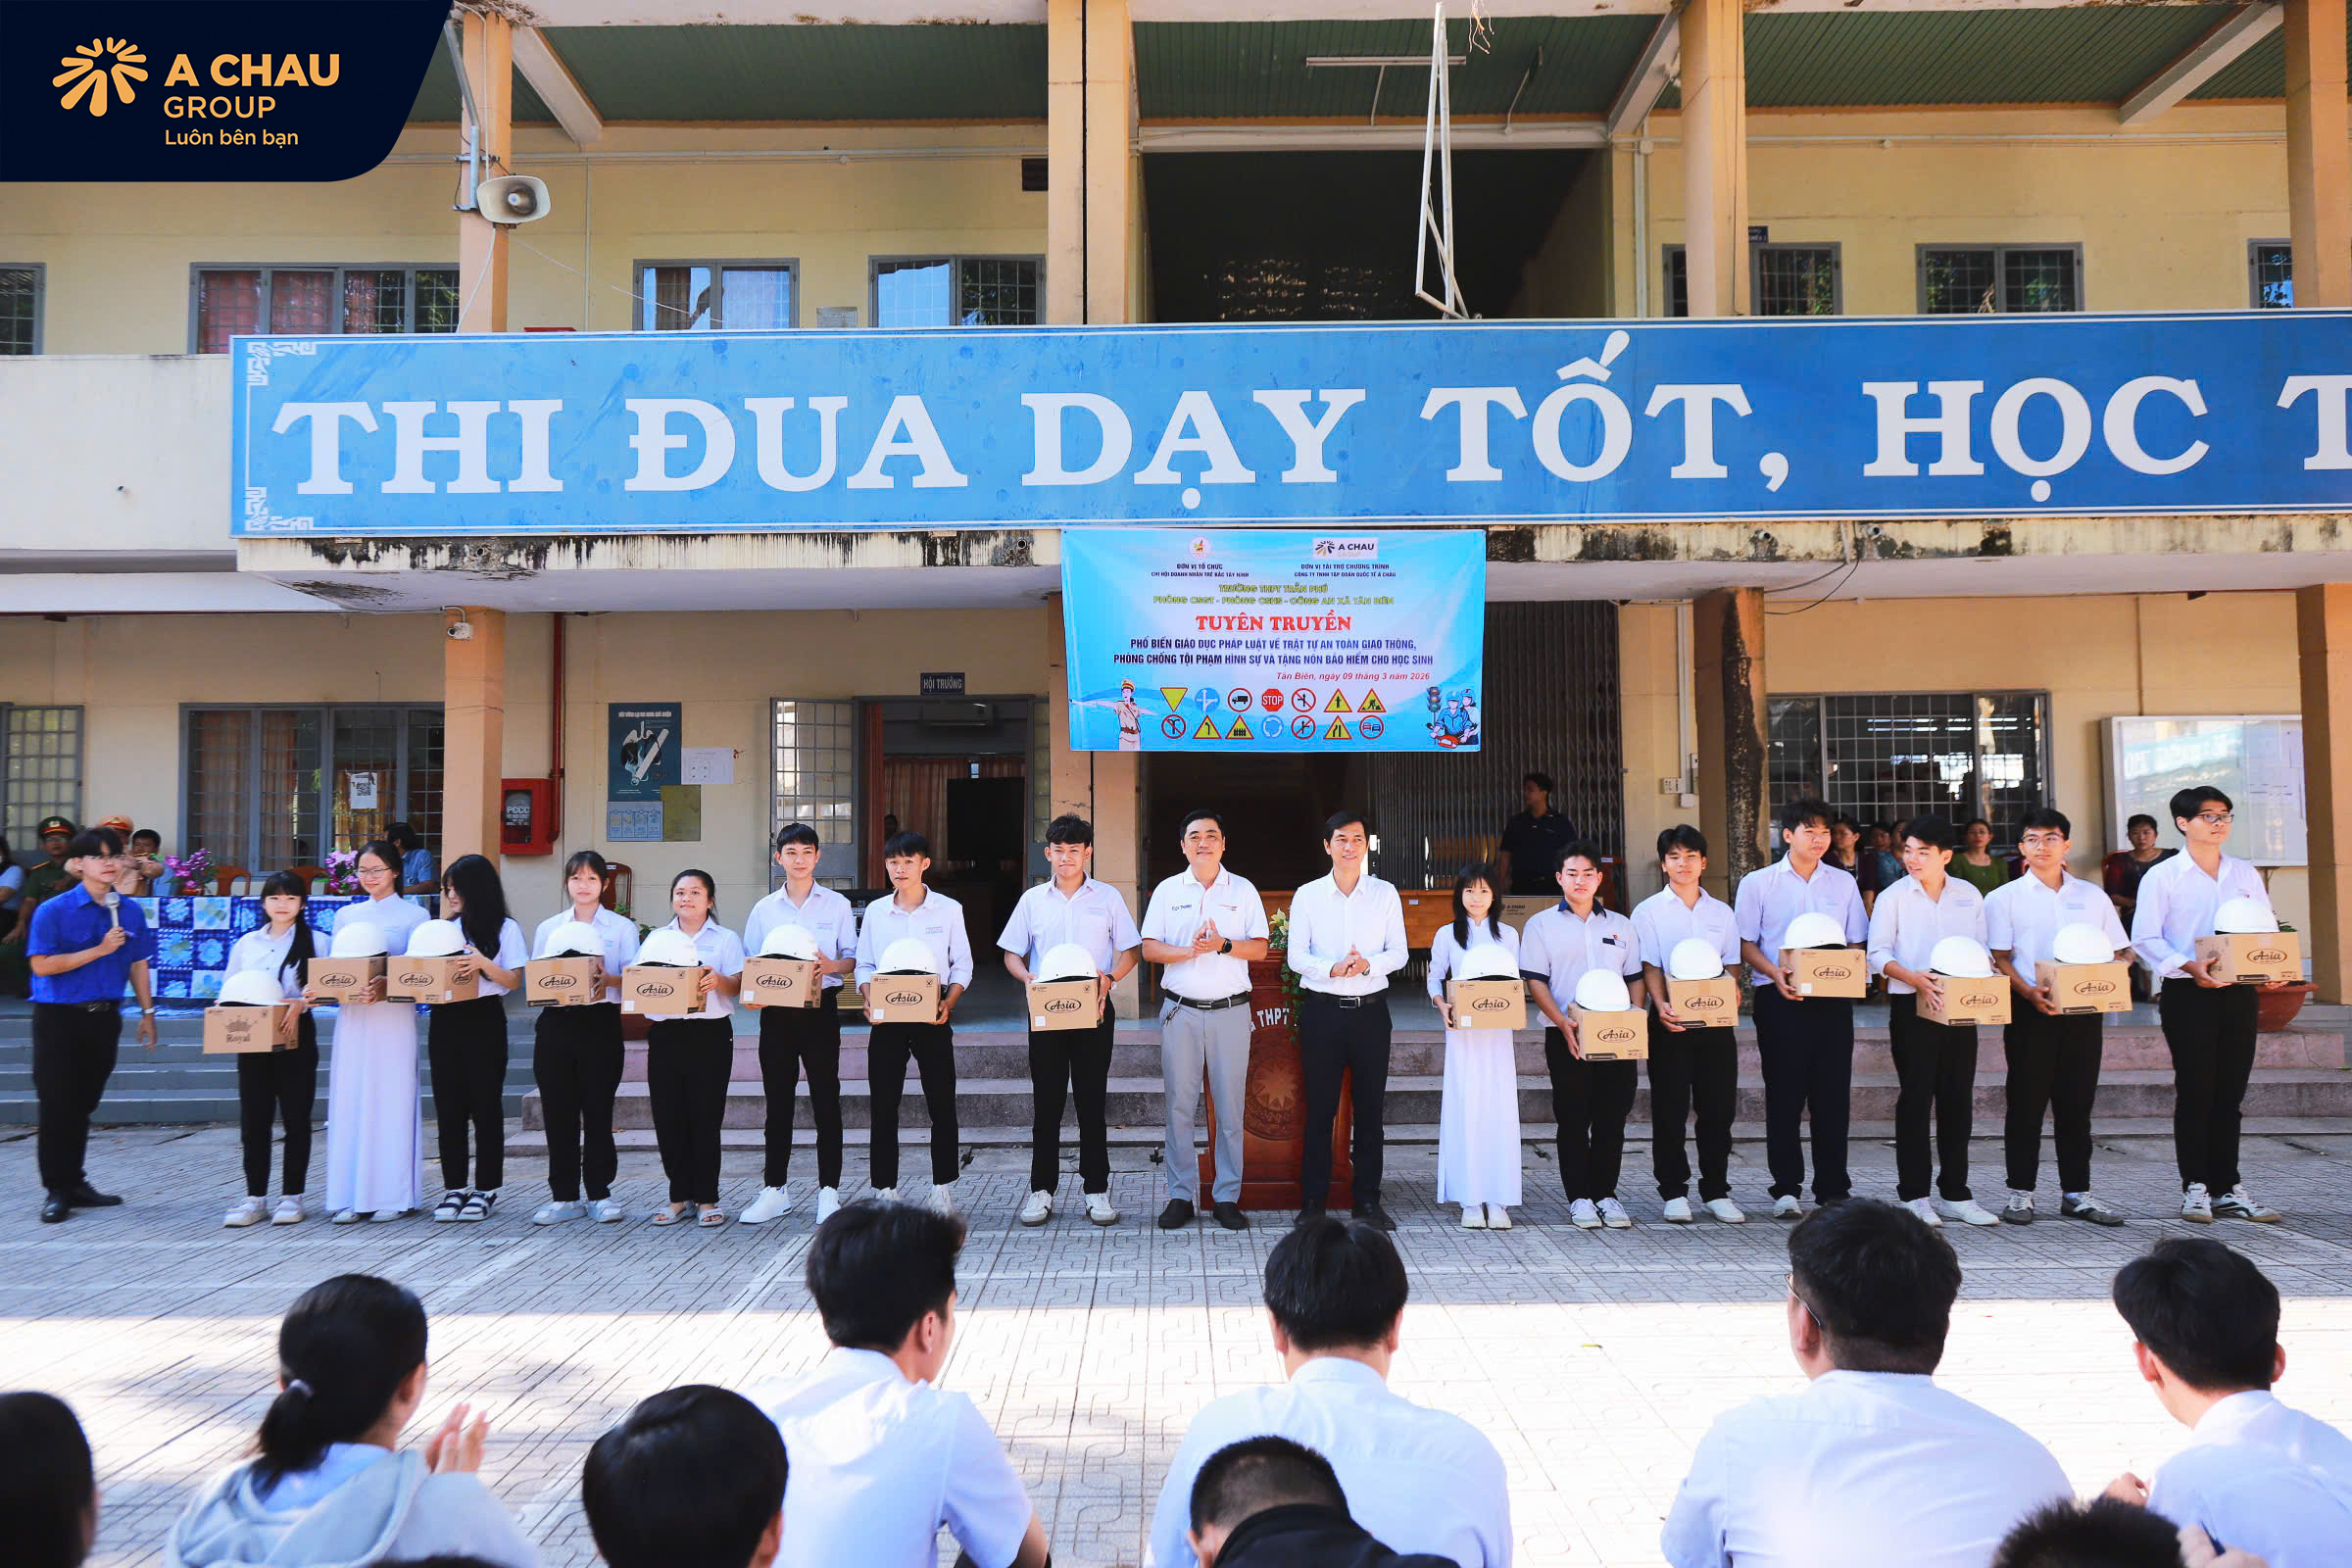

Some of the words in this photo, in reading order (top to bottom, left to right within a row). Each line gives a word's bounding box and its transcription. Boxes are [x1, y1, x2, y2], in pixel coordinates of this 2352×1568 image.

[272, 398, 564, 495] THI
[624, 394, 968, 493] ĐUA
[1020, 388, 1366, 510] DẠY
[1419, 329, 1789, 492] TỐT,
[1862, 375, 2210, 503] HỌC
[1196, 612, 1263, 631] TUYÊN
[1270, 610, 1351, 631] TRUYỀN
[1262, 695, 1283, 706] STOP
[506, 806, 530, 814] PCCC
[2253, 951, 2281, 960] Asia
[1819, 967, 1845, 976] Asia
[325, 975, 352, 984] Asia
[404, 974, 428, 984] Asia
[545, 977, 570, 986] Asia
[761, 975, 787, 986] Asia
[642, 984, 668, 994] Asia
[2081, 982, 2109, 993] Asia
[891, 993, 917, 1003] Asia
[1691, 998, 1717, 1007] Asia
[1966, 995, 1992, 1004] Asia
[1051, 1000, 1076, 1010] Asia
[1478, 999, 1504, 1008] Asia
[1256, 1007, 1290, 1028] THPT
[1603, 1029, 1629, 1039] Asia
